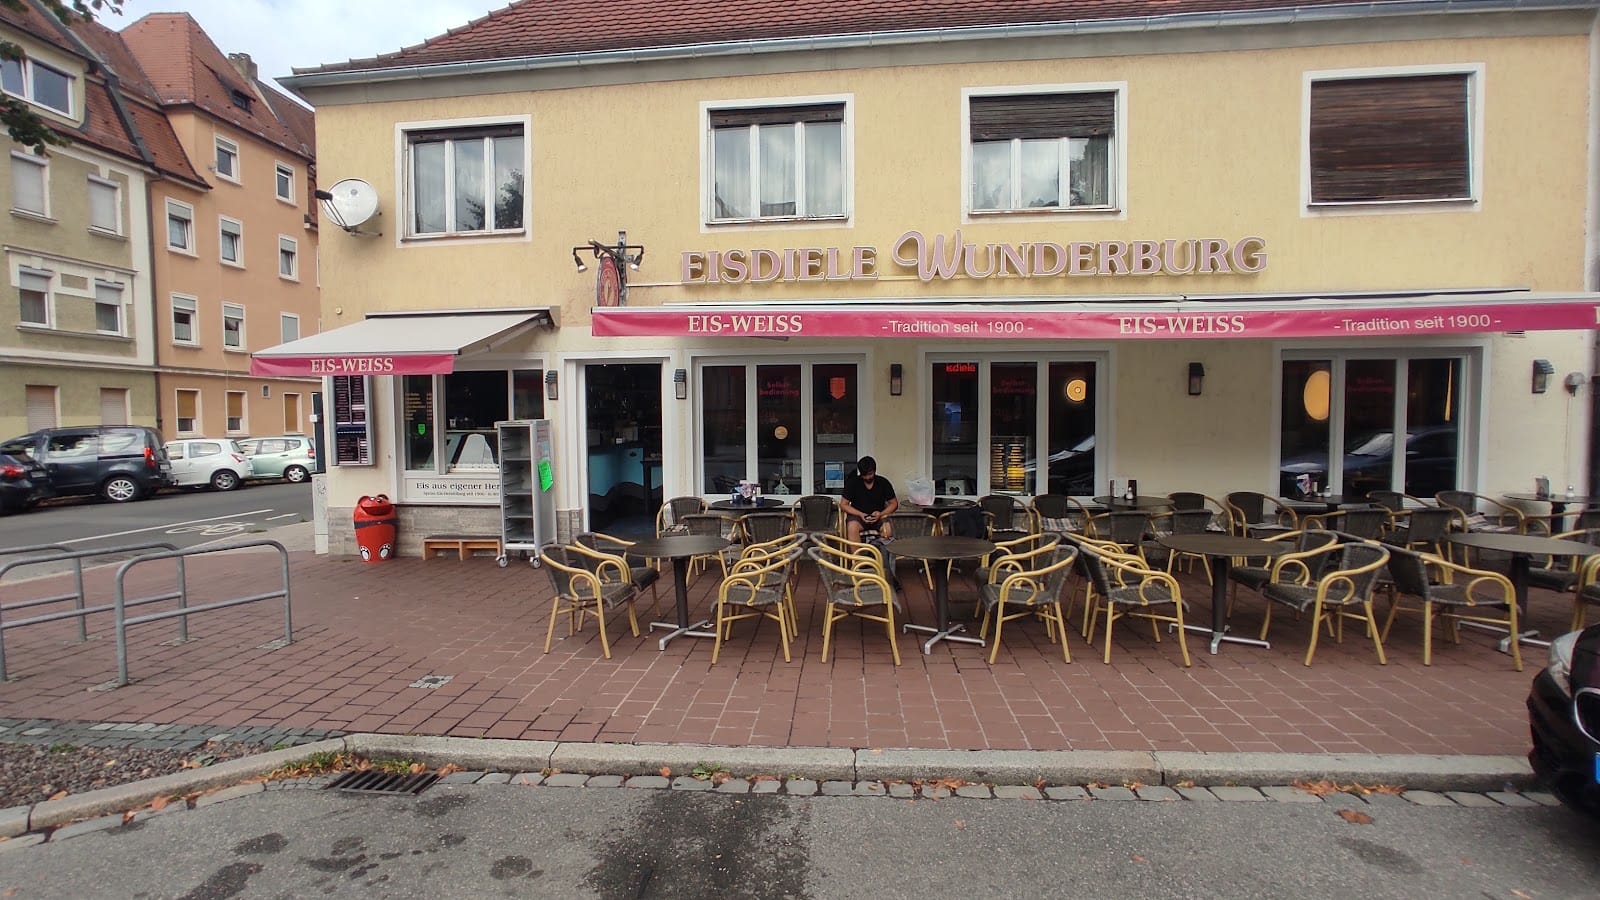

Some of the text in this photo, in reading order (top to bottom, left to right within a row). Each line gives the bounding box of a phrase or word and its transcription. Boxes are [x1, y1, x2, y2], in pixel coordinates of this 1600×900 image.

[680, 229, 1269, 284] EISDIELE WUNDERBURG
[687, 315, 803, 333] EIS-WEISS
[953, 321, 978, 333] seit
[986, 321, 1024, 333] 1900
[1119, 315, 1245, 335] EIS-WEISS
[1414, 316, 1445, 329] seit
[1448, 315, 1490, 328] 1900
[311, 357, 394, 373] EIS-WEISS
[449, 482, 481, 491] eigener
